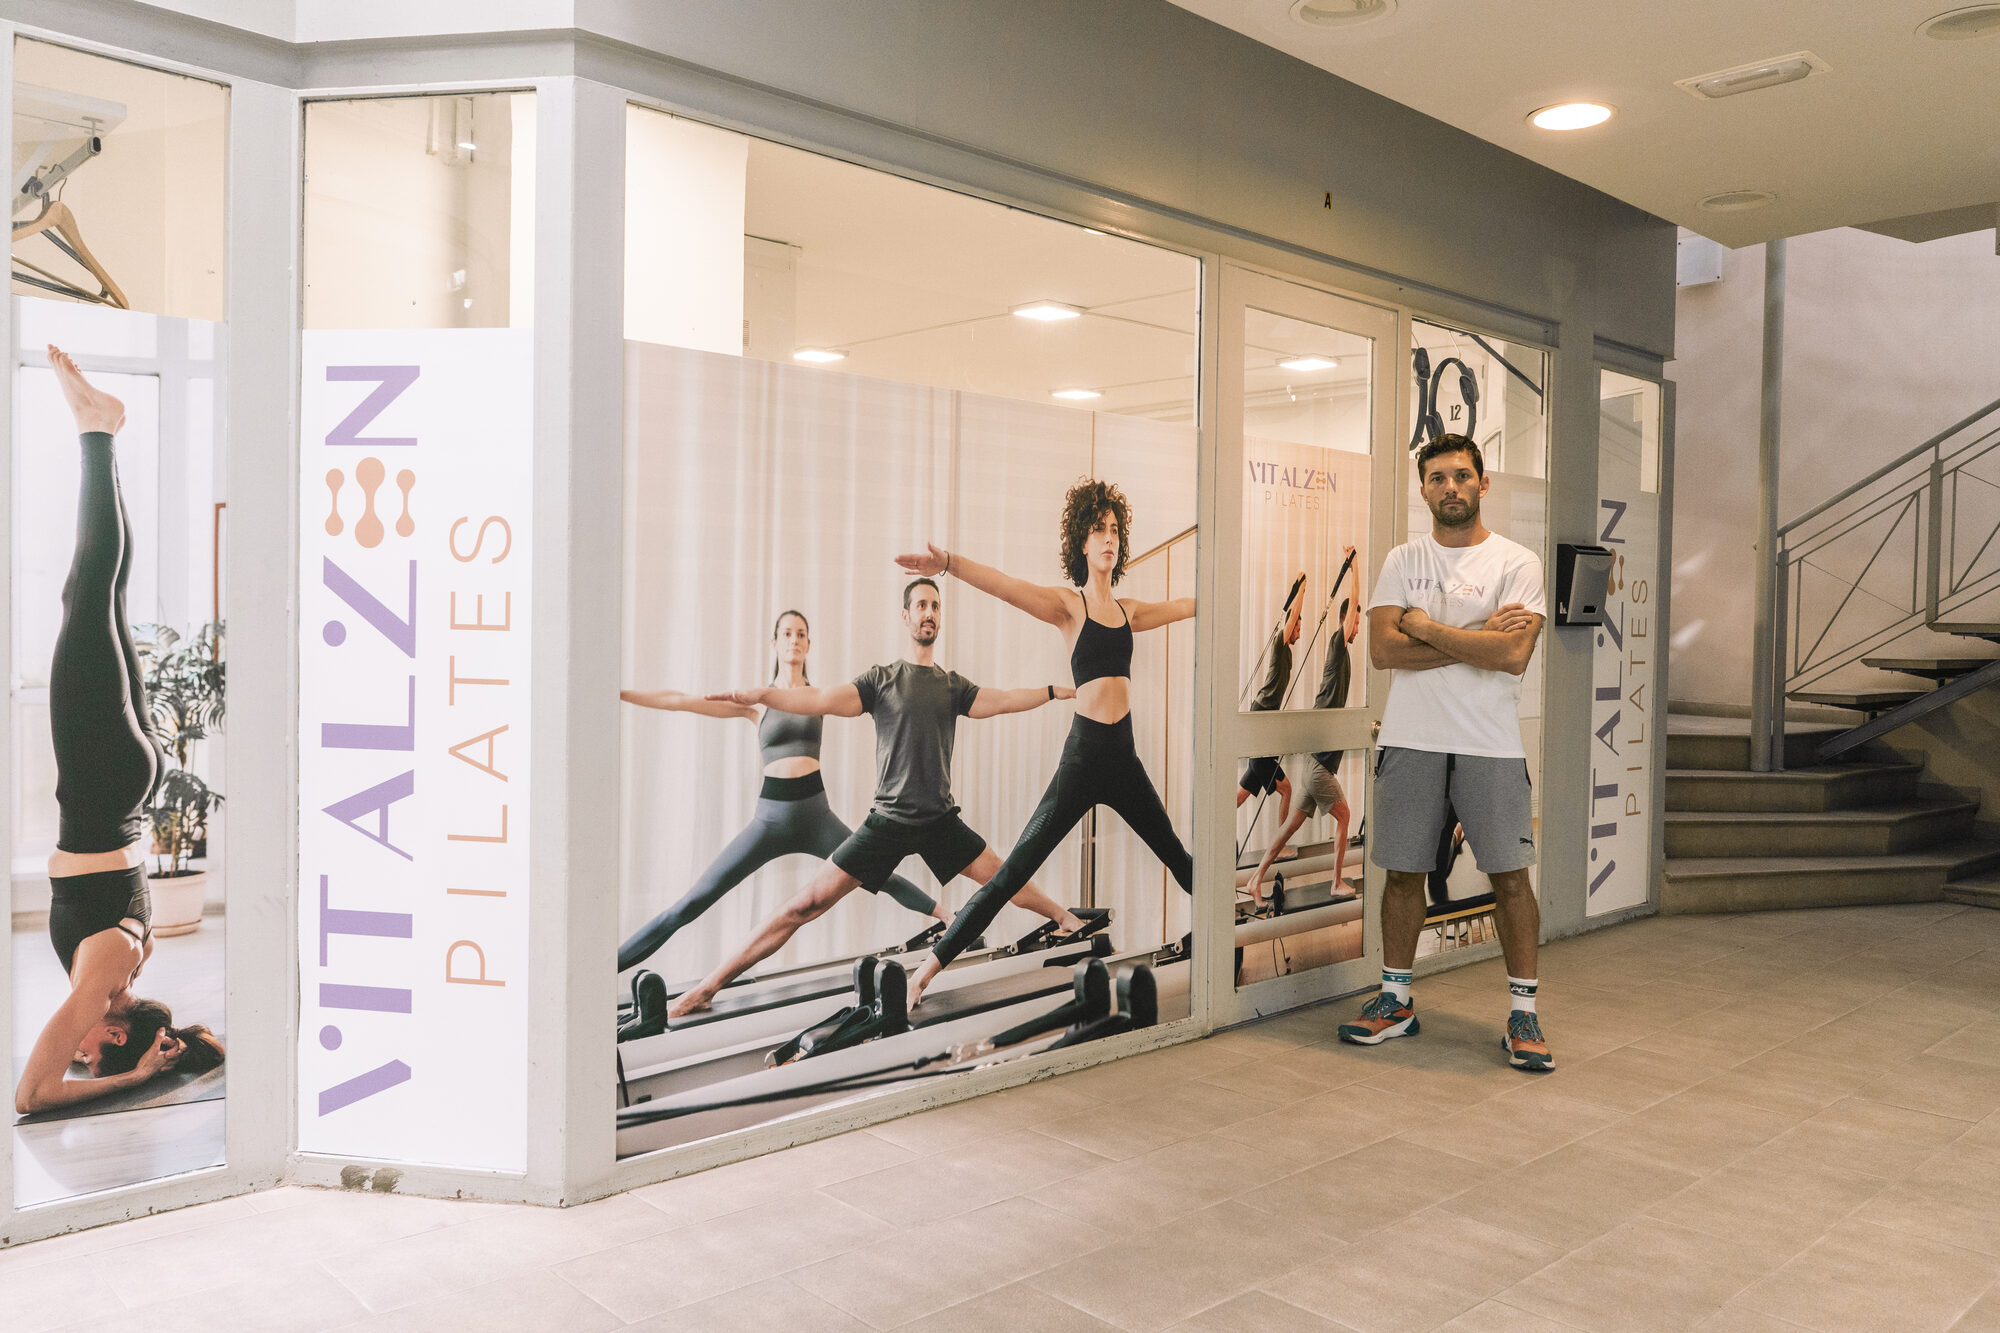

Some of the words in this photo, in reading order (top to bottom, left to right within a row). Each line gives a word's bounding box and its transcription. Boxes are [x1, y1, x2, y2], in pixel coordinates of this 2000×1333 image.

[1324, 192, 1332, 210] A
[1449, 404, 1462, 421] 12
[1248, 460, 1337, 493] VITALZEN
[1265, 490, 1320, 511] PILATES
[1408, 578, 1485, 598] VITAZEN
[1625, 580, 1648, 816] PILATES
[318, 365, 420, 1117] VITALZEN
[446, 515, 512, 987] PILATES
